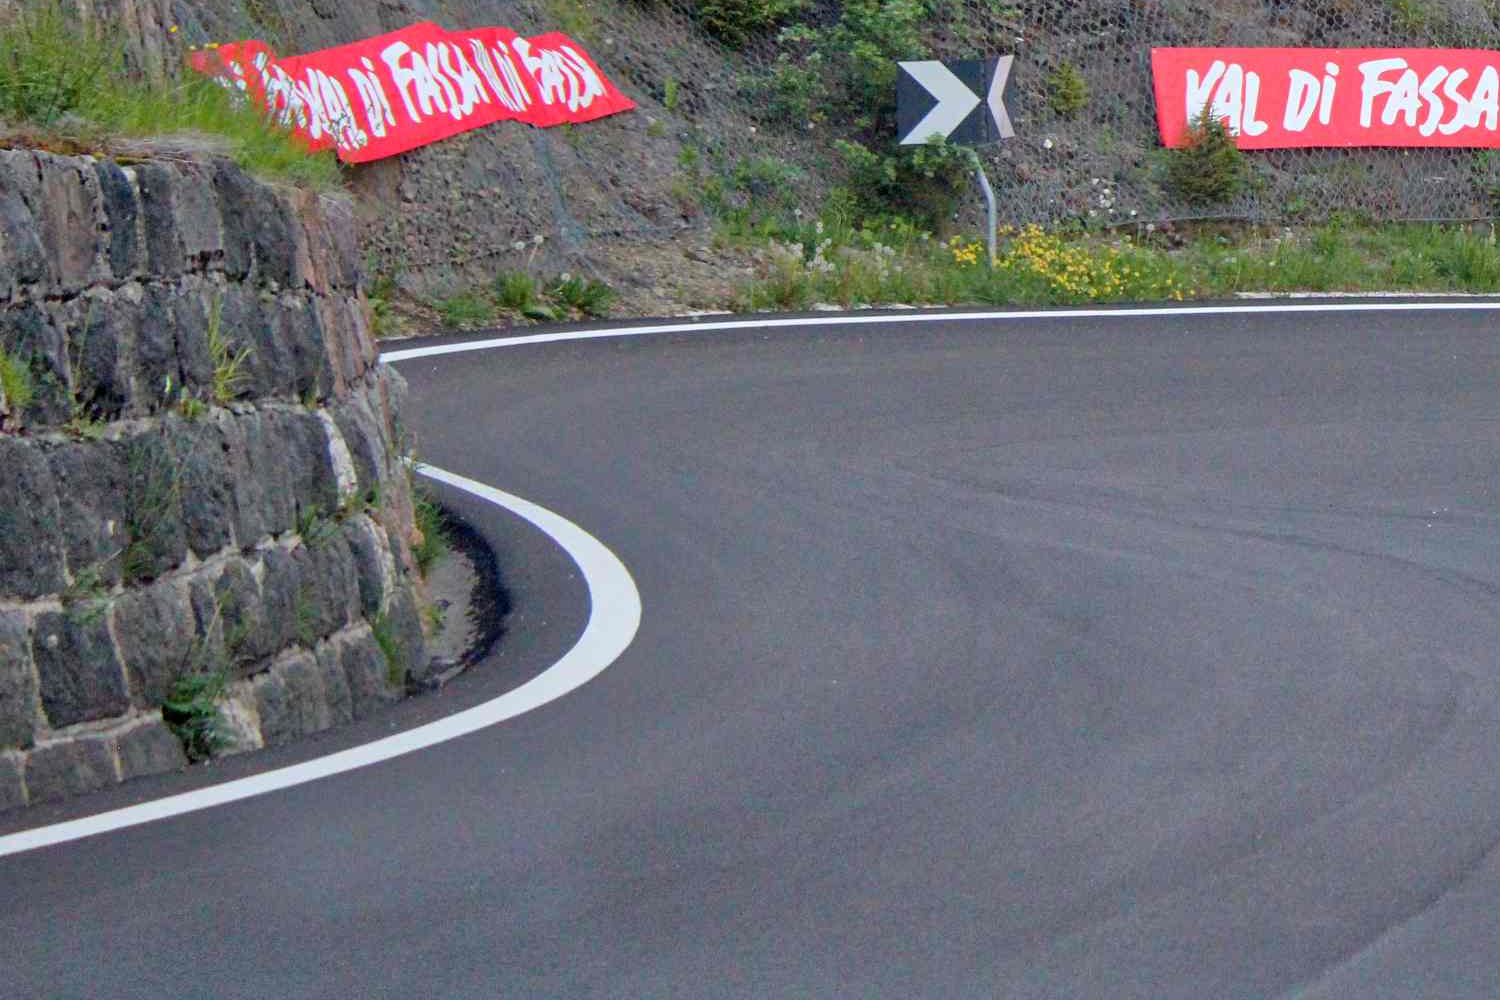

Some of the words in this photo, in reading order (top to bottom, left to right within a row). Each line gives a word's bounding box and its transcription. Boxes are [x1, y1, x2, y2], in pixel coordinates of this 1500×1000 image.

[380, 41, 490, 121] FASSA
[1185, 60, 1268, 137] VAL
[1283, 62, 1340, 132] Di
[1358, 57, 1500, 137] FASSA
